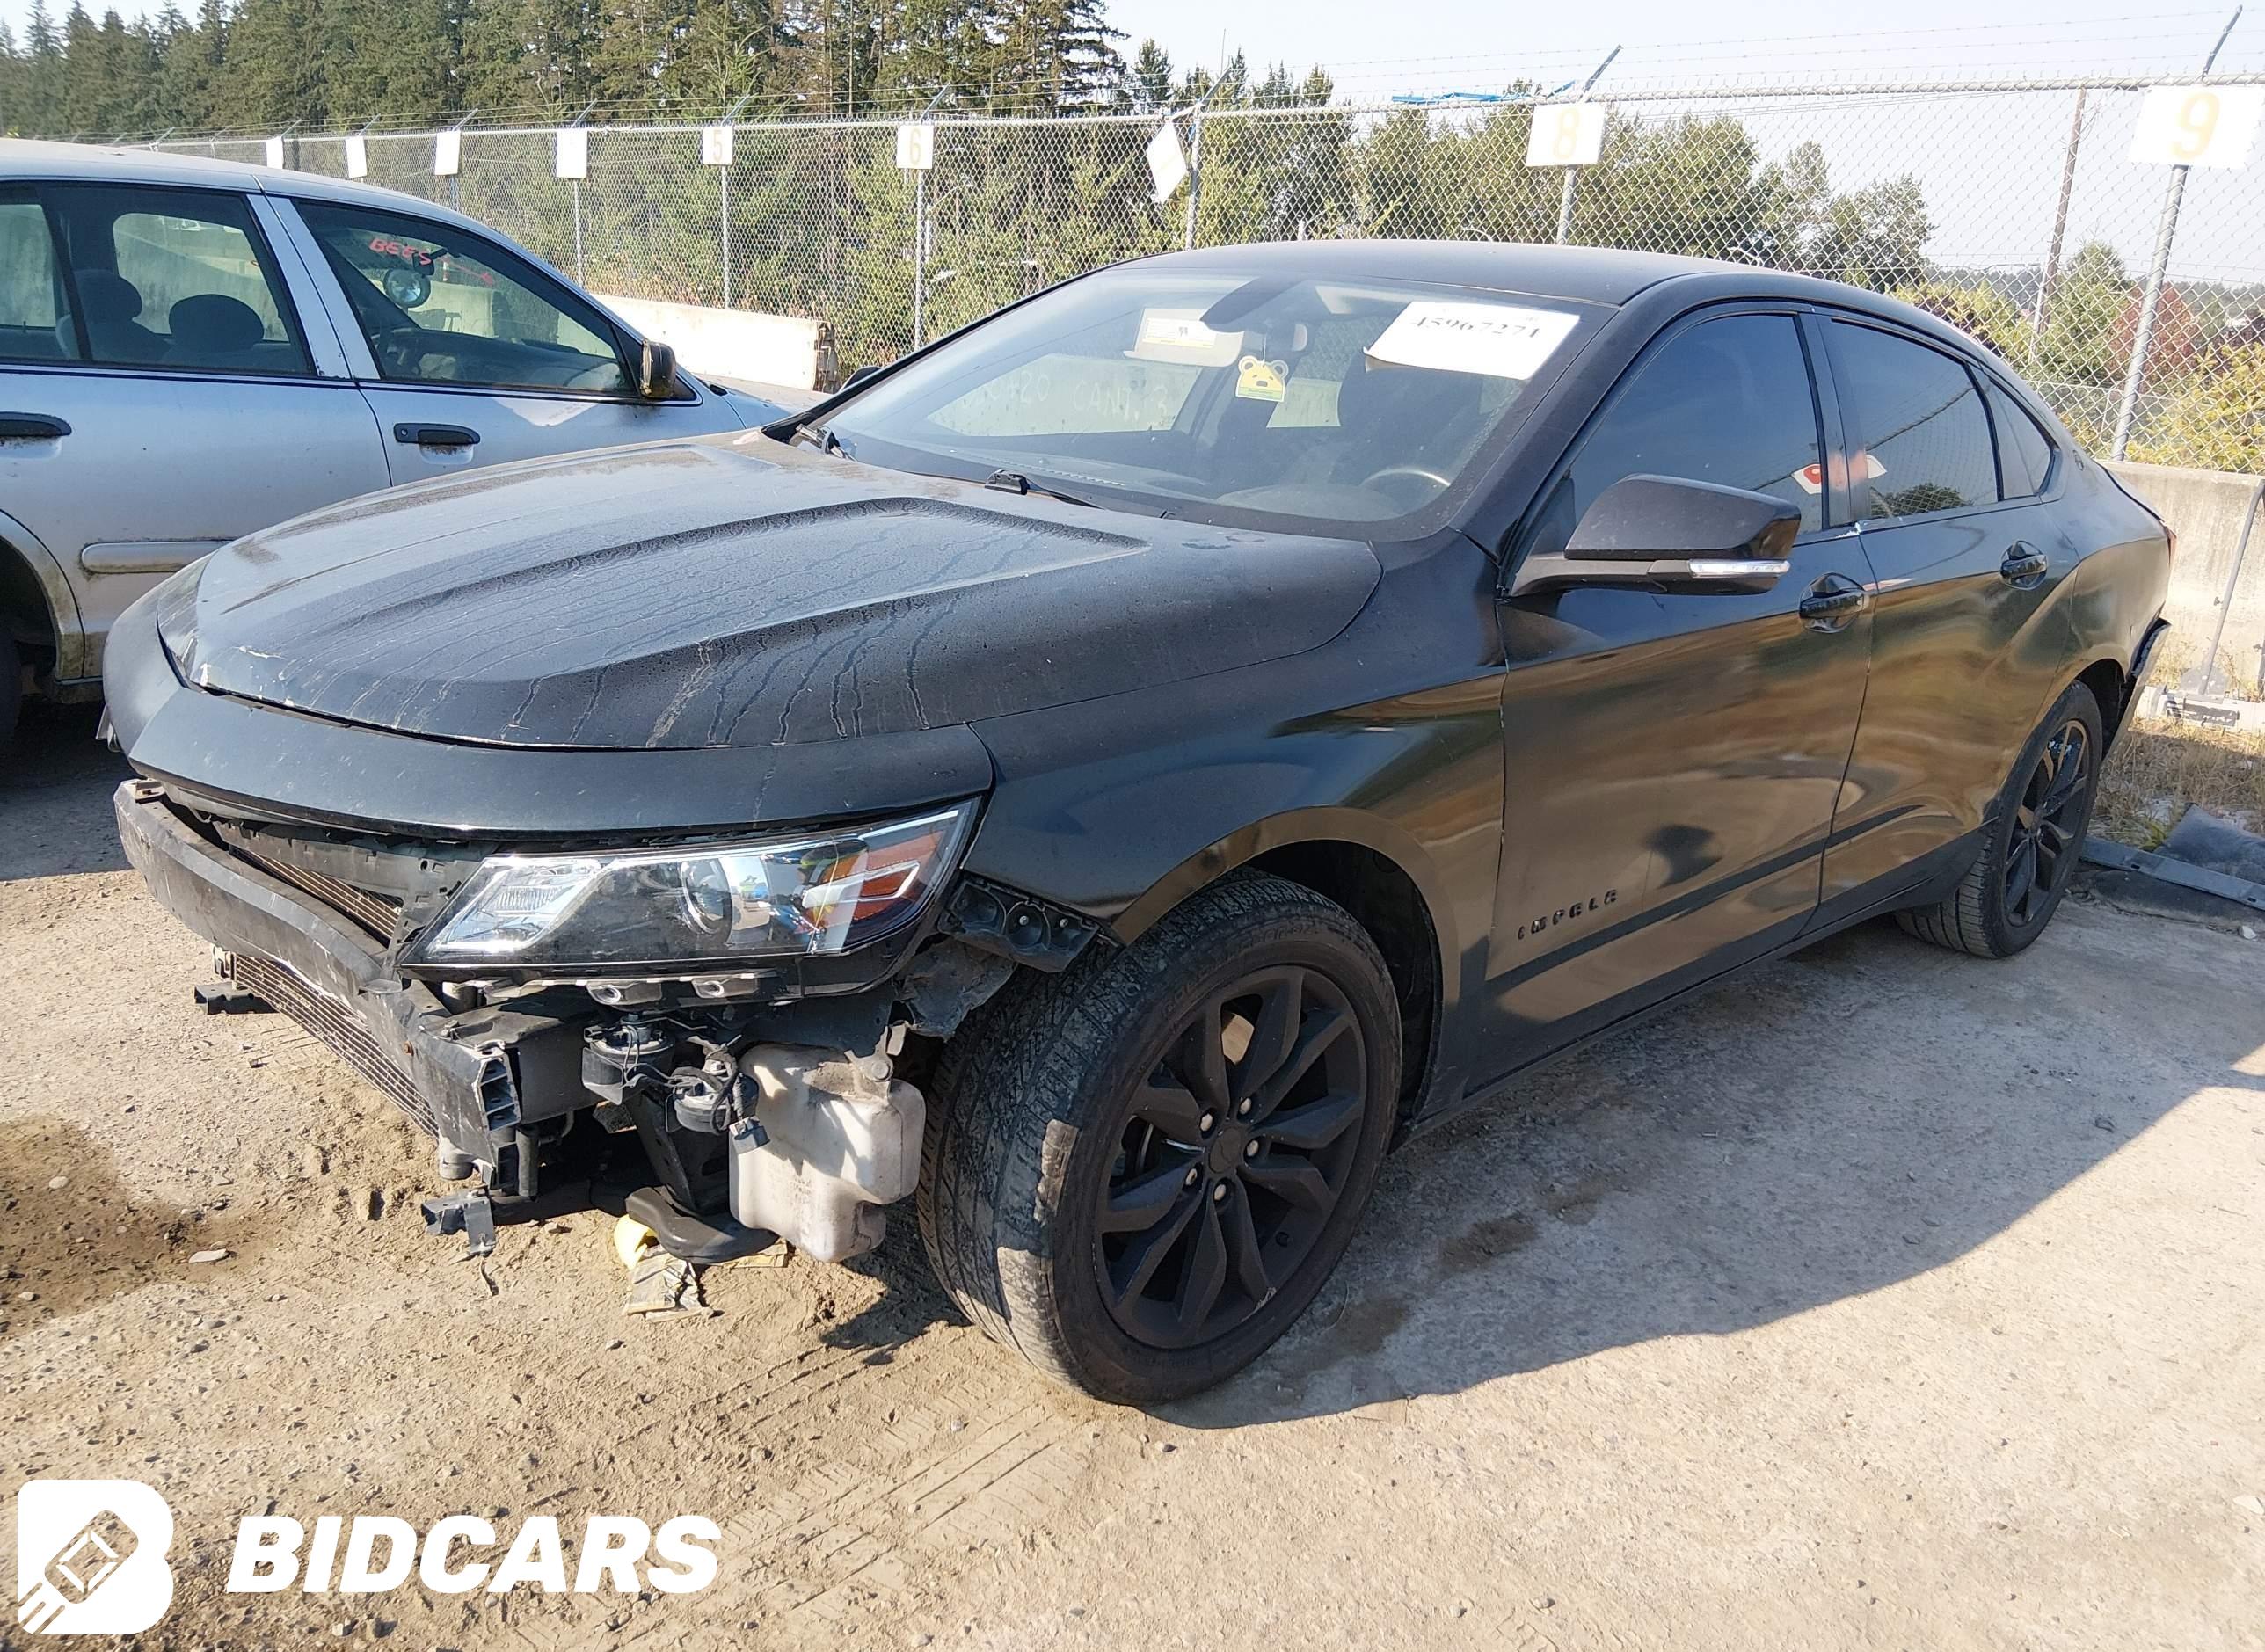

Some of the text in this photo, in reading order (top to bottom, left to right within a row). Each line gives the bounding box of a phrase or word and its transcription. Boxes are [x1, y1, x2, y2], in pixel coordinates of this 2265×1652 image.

[712, 128, 724, 161] 5
[909, 127, 921, 165] 6
[1552, 108, 1577, 159] 8
[2170, 91, 2219, 160] 9
[368, 237, 432, 266] BEES
[1517, 889, 1617, 940] IMPALA
